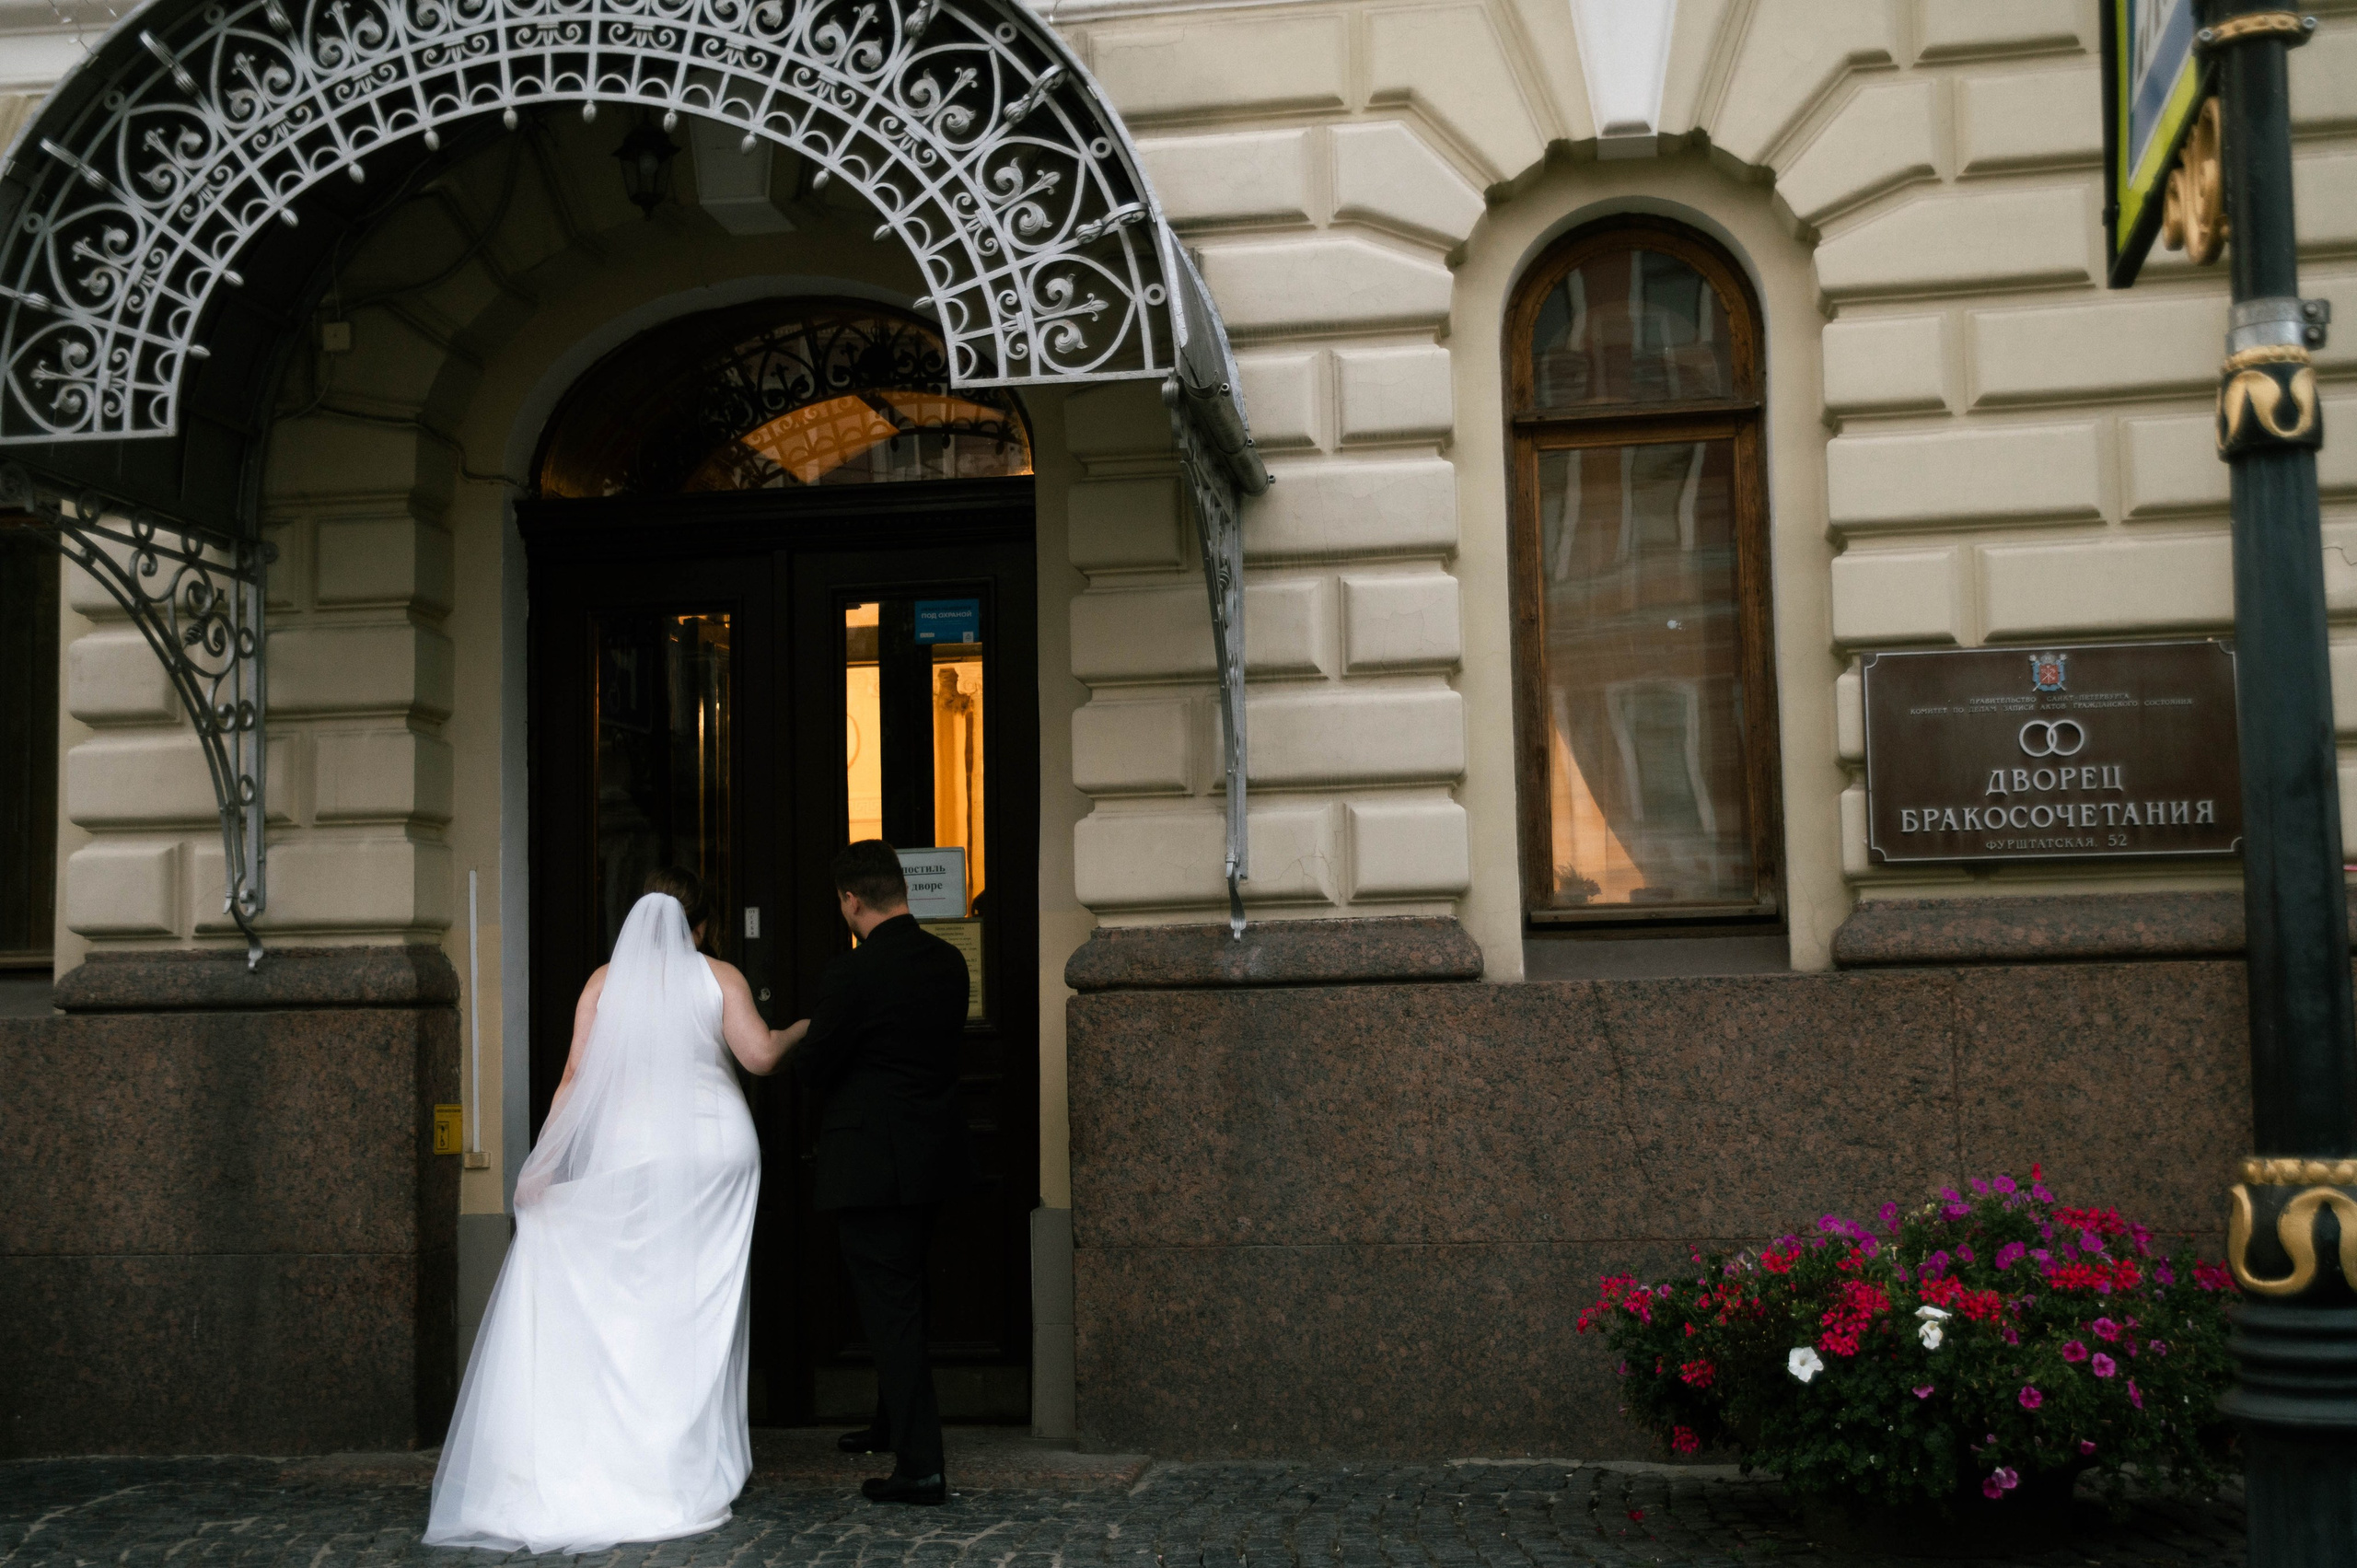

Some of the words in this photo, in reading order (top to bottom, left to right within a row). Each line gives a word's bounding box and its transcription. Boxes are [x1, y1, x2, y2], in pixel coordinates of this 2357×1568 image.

[938, 610, 972, 618] ОХРАНОЙ
[1910, 706, 1948, 715] КОМИТЕТ
[2003, 703, 2035, 713] ЗАПИСИ
[2039, 703, 2067, 711] АКТОВ
[2073, 700, 2138, 709] ГРАЖДАНСКОГО
[1985, 765, 2124, 796] ДВОРЕЦ
[1900, 799, 2216, 833] БРАКОСОЧЕТАНИЯ
[2107, 834, 2128, 847] 52
[901, 865, 946, 874] постиль
[911, 882, 943, 892] дворе
